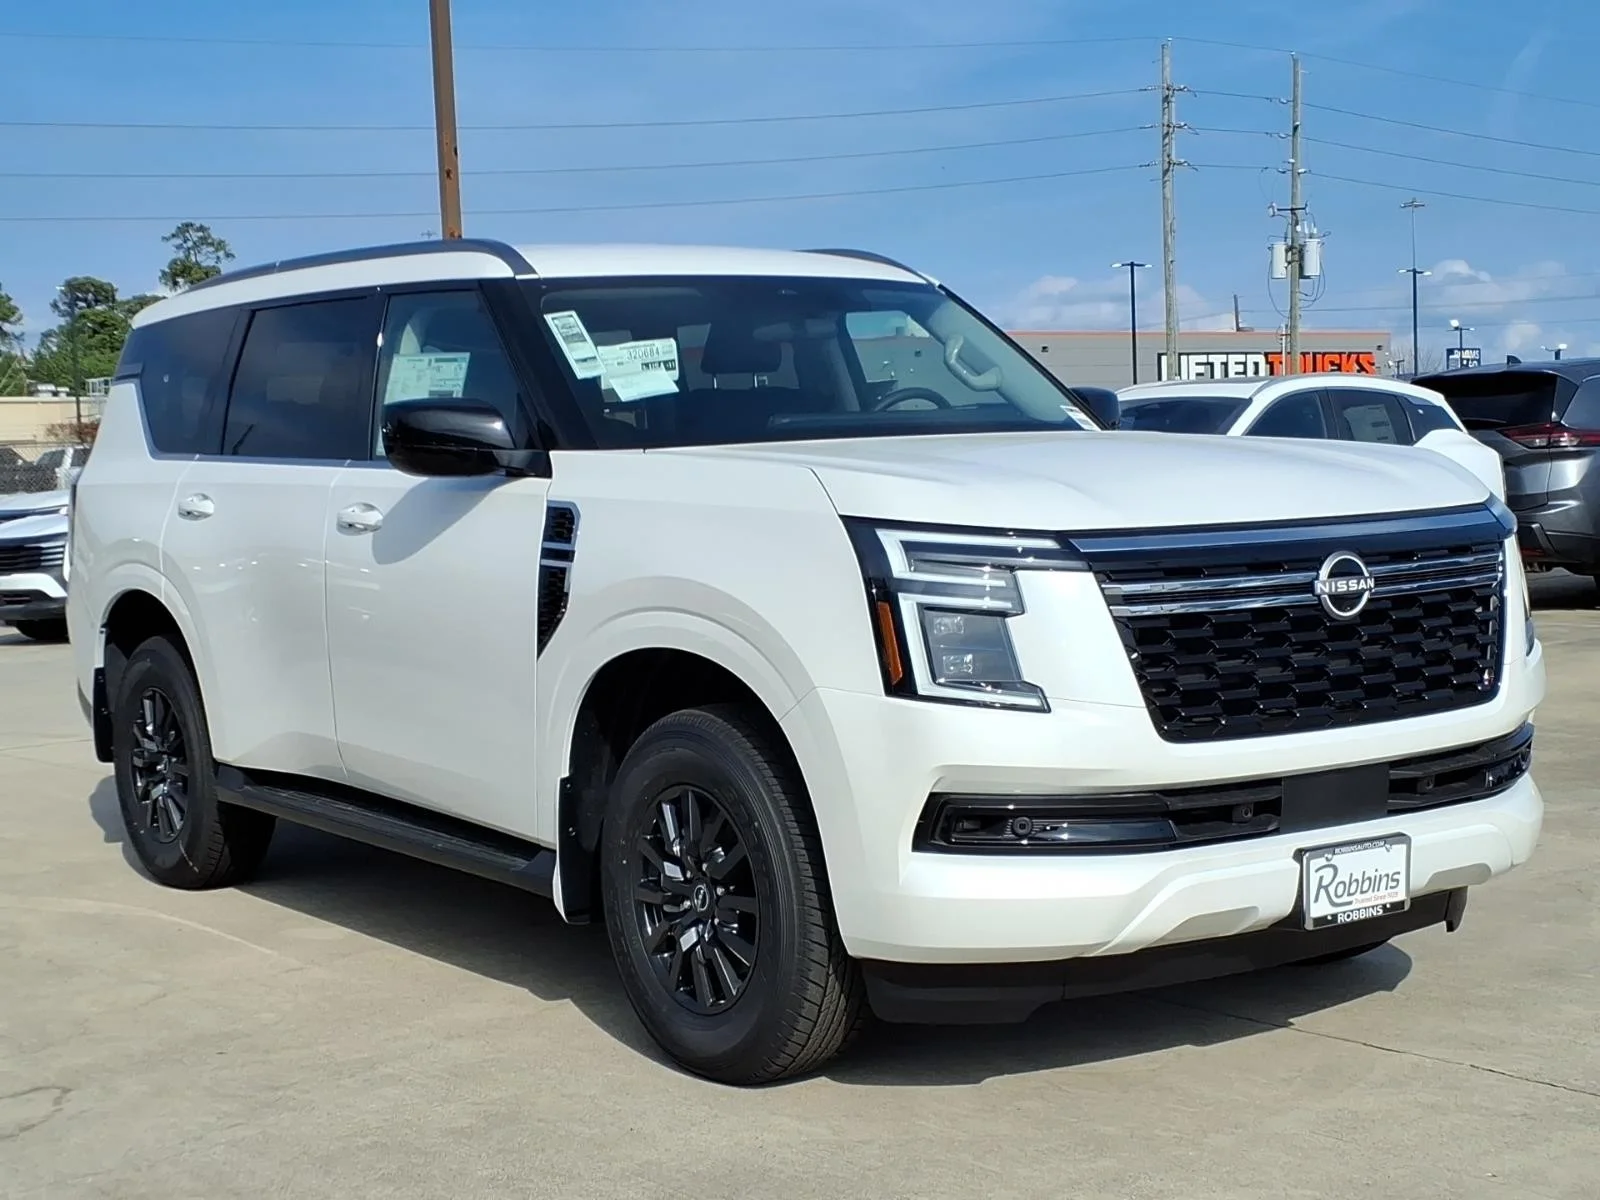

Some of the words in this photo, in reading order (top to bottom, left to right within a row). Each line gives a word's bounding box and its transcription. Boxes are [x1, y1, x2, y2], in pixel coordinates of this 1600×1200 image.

[627, 347, 660, 361] 320684
[1317, 578, 1375, 594] NISSAN
[1313, 863, 1401, 908] Robbins
[1337, 905, 1384, 924] ROBBINS
